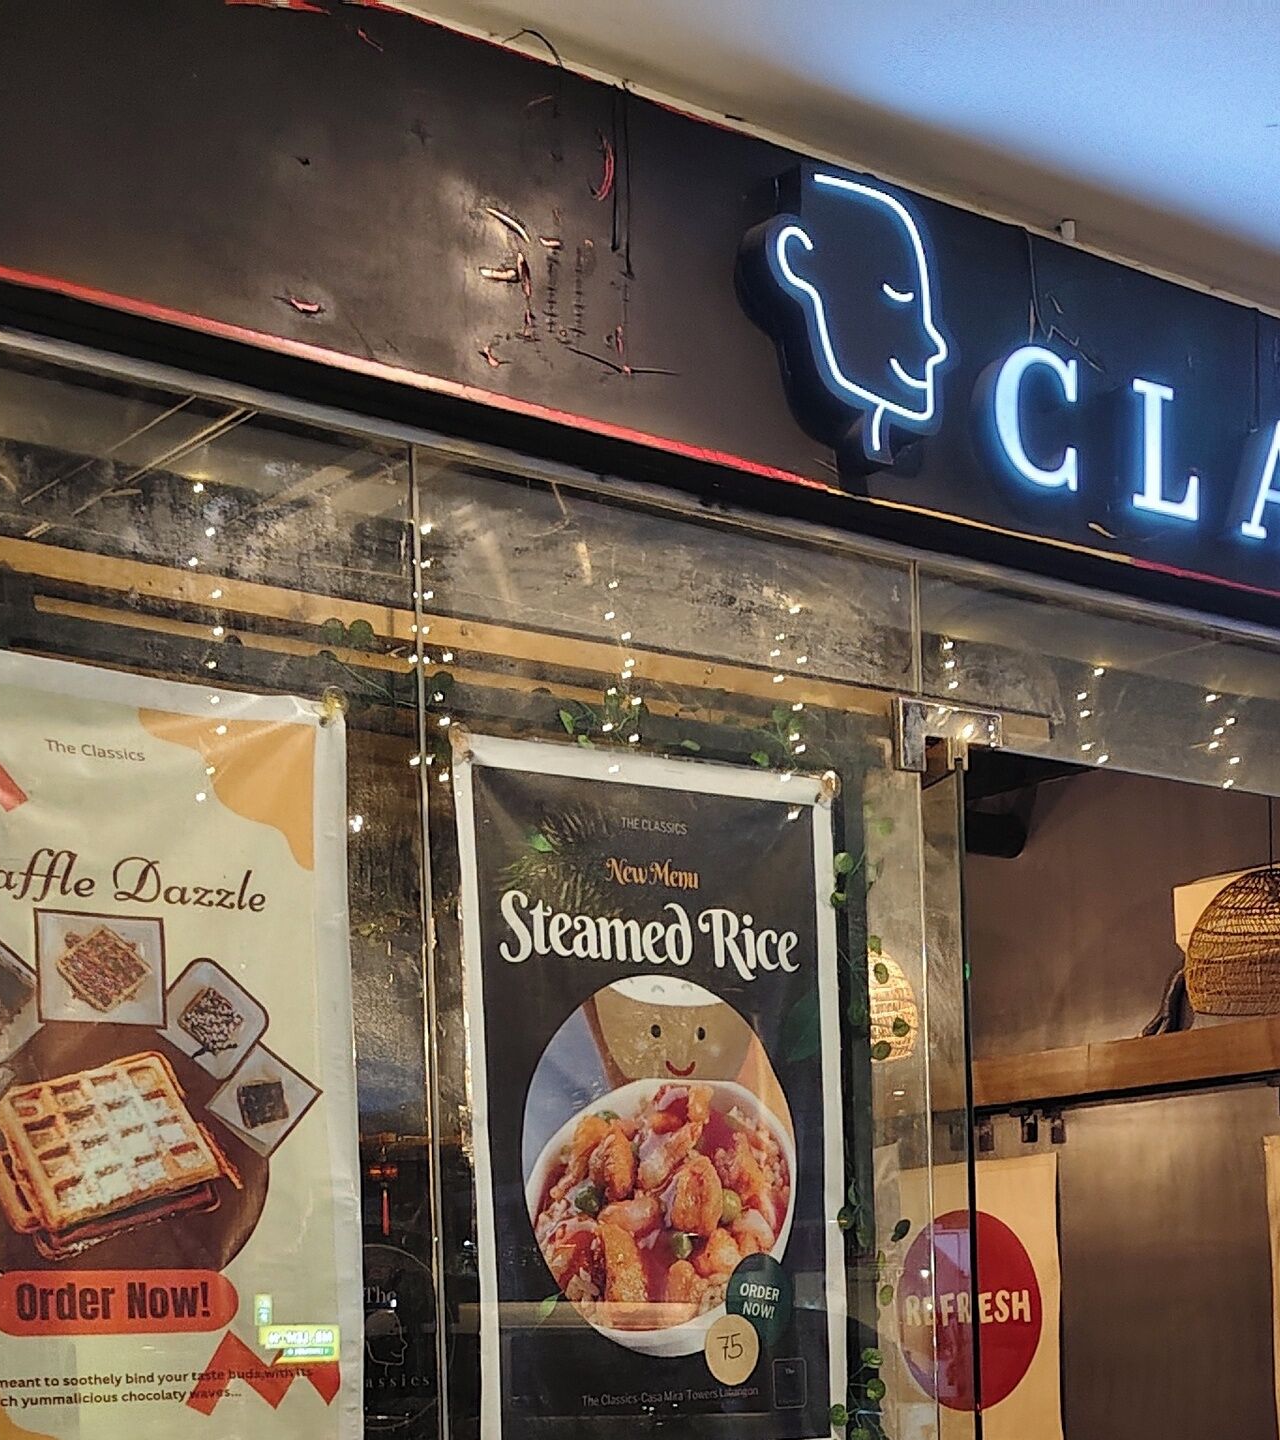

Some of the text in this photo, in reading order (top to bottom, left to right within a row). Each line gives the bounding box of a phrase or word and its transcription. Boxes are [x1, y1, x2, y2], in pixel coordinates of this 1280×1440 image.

[44, 738, 145, 761] The Classics
[621, 816, 688, 835] THE CLASSICS
[113, 856, 267, 912] Dazzle
[605, 857, 700, 891] New Menu
[499, 889, 801, 982] Steamed Rice
[16, 1280, 211, 1321] Order Now!
[740, 1282, 780, 1301] ORDER
[742, 1301, 776, 1319] NOW!
[905, 1289, 1032, 1327] REFRESH
[716, 1332, 744, 1361] 75
[45, 1377, 60, 1387] to
[63, 1373, 122, 1388] soothely
[125, 1371, 155, 1385] bind
[158, 1372, 189, 1386] your
[192, 1369, 224, 1381] taste
[21, 1392, 118, 1408] yummalicious
[121, 1389, 186, 1403] chocolaty
